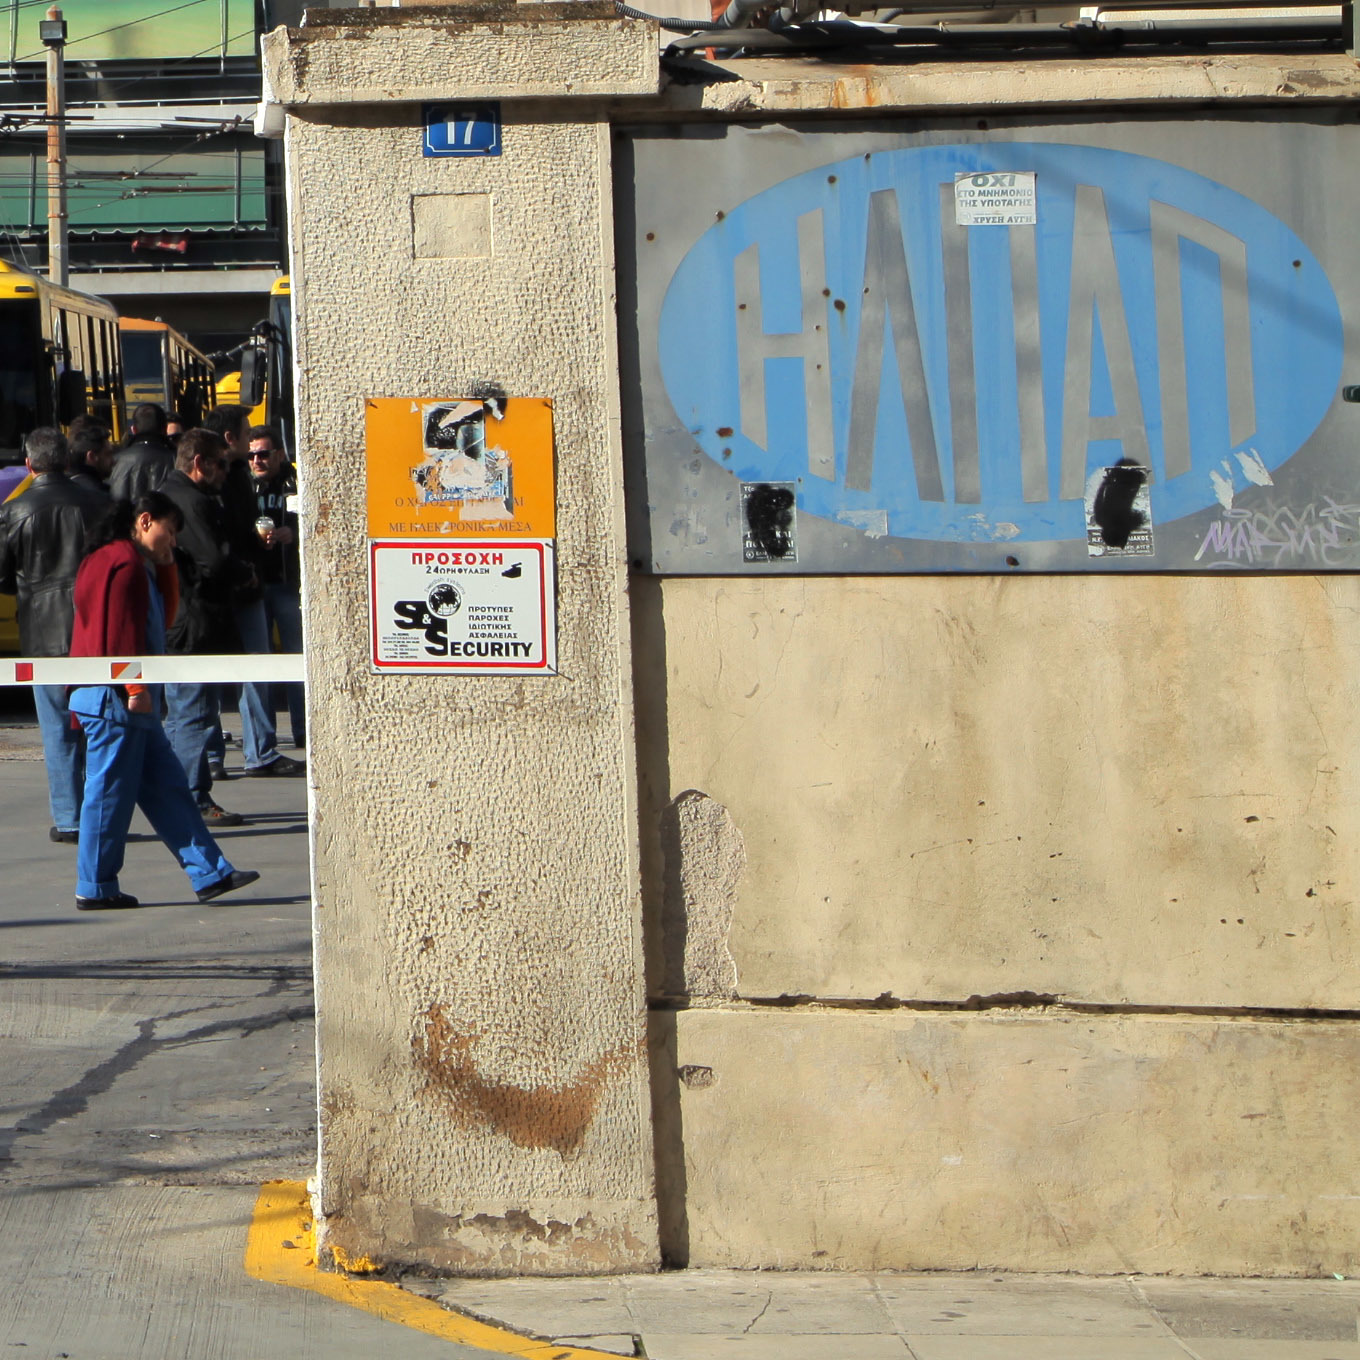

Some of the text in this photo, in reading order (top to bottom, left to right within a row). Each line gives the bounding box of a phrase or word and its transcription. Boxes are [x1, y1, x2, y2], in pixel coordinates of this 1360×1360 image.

[443, 112, 477, 145] 17
[971, 175, 1016, 187] ΟΧΙ
[978, 189, 1033, 197] ΜΝΗΜΟΝΙΟ
[960, 199, 1032, 208] ΤΗΣ ΥΠΟΤΑΓΗΣ
[1007, 215, 1032, 223] ΑΥΓΗ
[389, 522, 406, 532] ΜΕ
[498, 522, 532, 532] ΜΕΣΑ
[411, 552, 503, 565] ΠΡΟΣΟΧΗ
